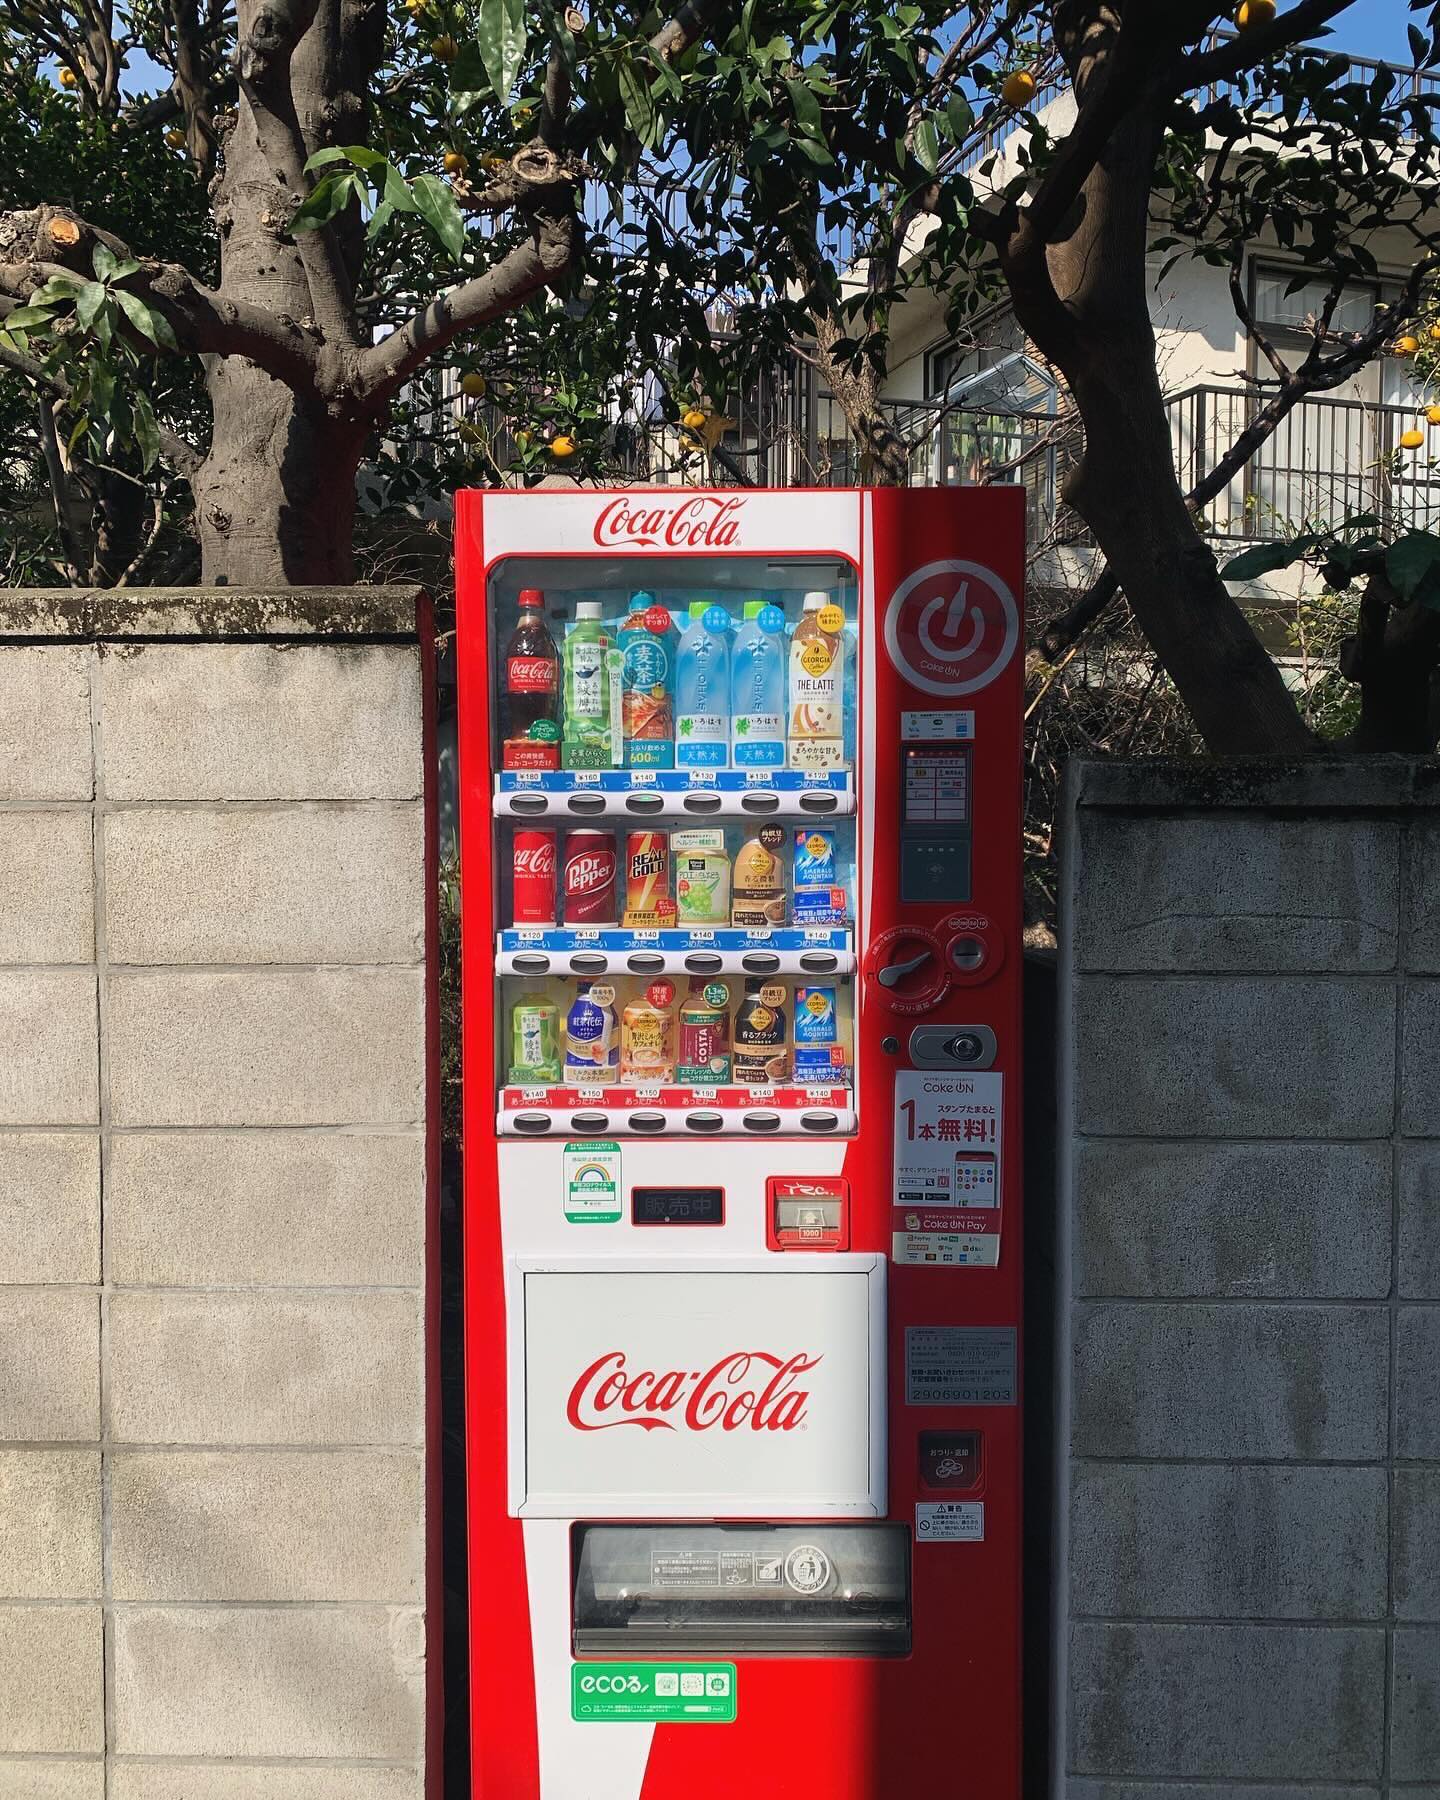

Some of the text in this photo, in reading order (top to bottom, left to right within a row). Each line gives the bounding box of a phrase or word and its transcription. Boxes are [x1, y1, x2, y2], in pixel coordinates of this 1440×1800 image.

[593, 497, 748, 547] Coca-Cola
[634, 646, 655, 685] 麦茶
[803, 656, 831, 664] GEORGIA
[511, 660, 553, 679] Coca-Cola
[798, 679, 834, 691] THE LATTE
[686, 751, 719, 760] 天然水
[743, 751, 776, 760] 天然水
[632, 848, 667, 865] REAL
[580, 857, 600, 872] Dr
[632, 862, 664, 879] GOLD
[568, 864, 611, 890] Pepper
[652, 986, 668, 994] 国産
[653, 994, 668, 1002] 牛乳
[572, 1016, 603, 1027] 紅茶花伝
[742, 1031, 778, 1039] 香るブラック
[698, 1028, 708, 1063] COSTA
[923, 1081, 974, 1093] Coke ON
[938, 1105, 996, 1114] スタンプたまると
[646, 1197, 711, 1216] 販売中
[923, 1219, 987, 1231] Coke ON Pay
[567, 1352, 824, 1432] Coca-Cola
[912, 1389, 1010, 1400] 2906901203
[930, 1449, 969, 1457] おつり・返却
